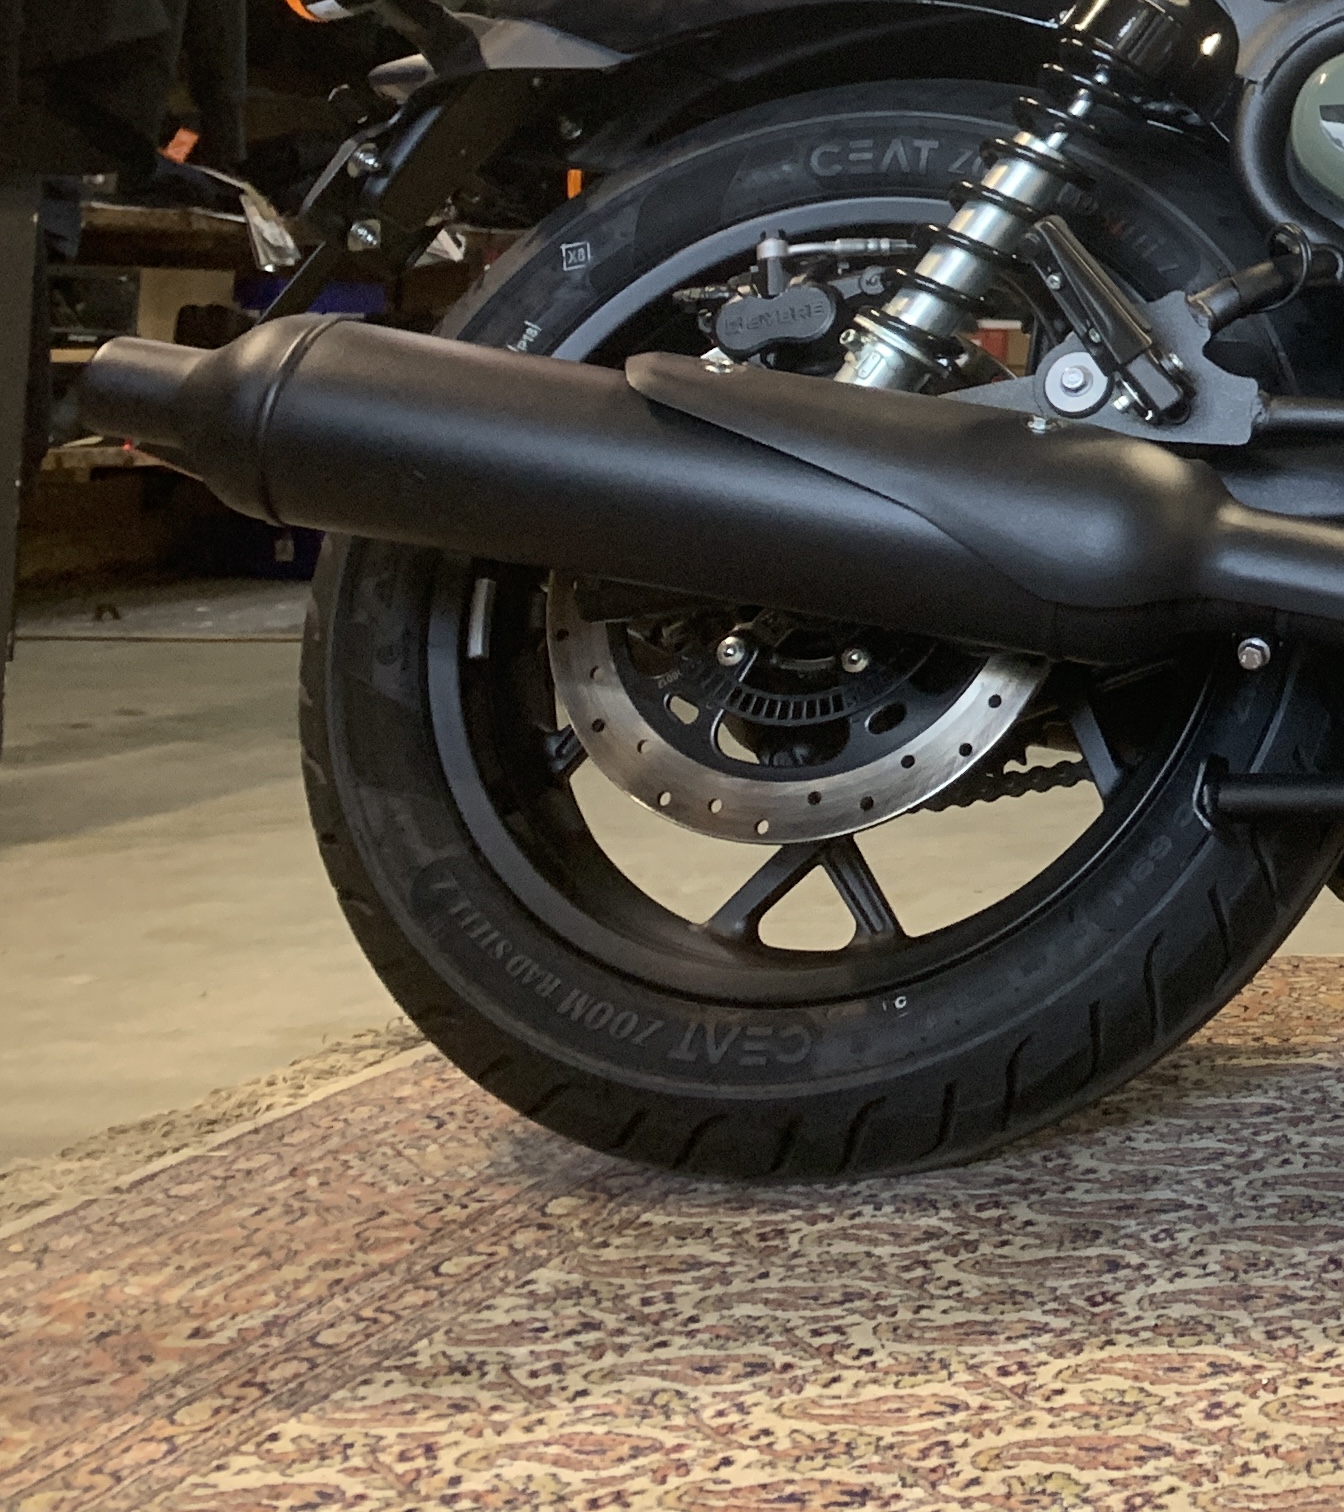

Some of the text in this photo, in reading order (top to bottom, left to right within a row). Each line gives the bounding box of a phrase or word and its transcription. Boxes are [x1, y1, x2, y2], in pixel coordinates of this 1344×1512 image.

[810, 135, 939, 177] CEAT
[556, 987, 664, 1047] ZOOM
[666, 1018, 813, 1066] CEAT
